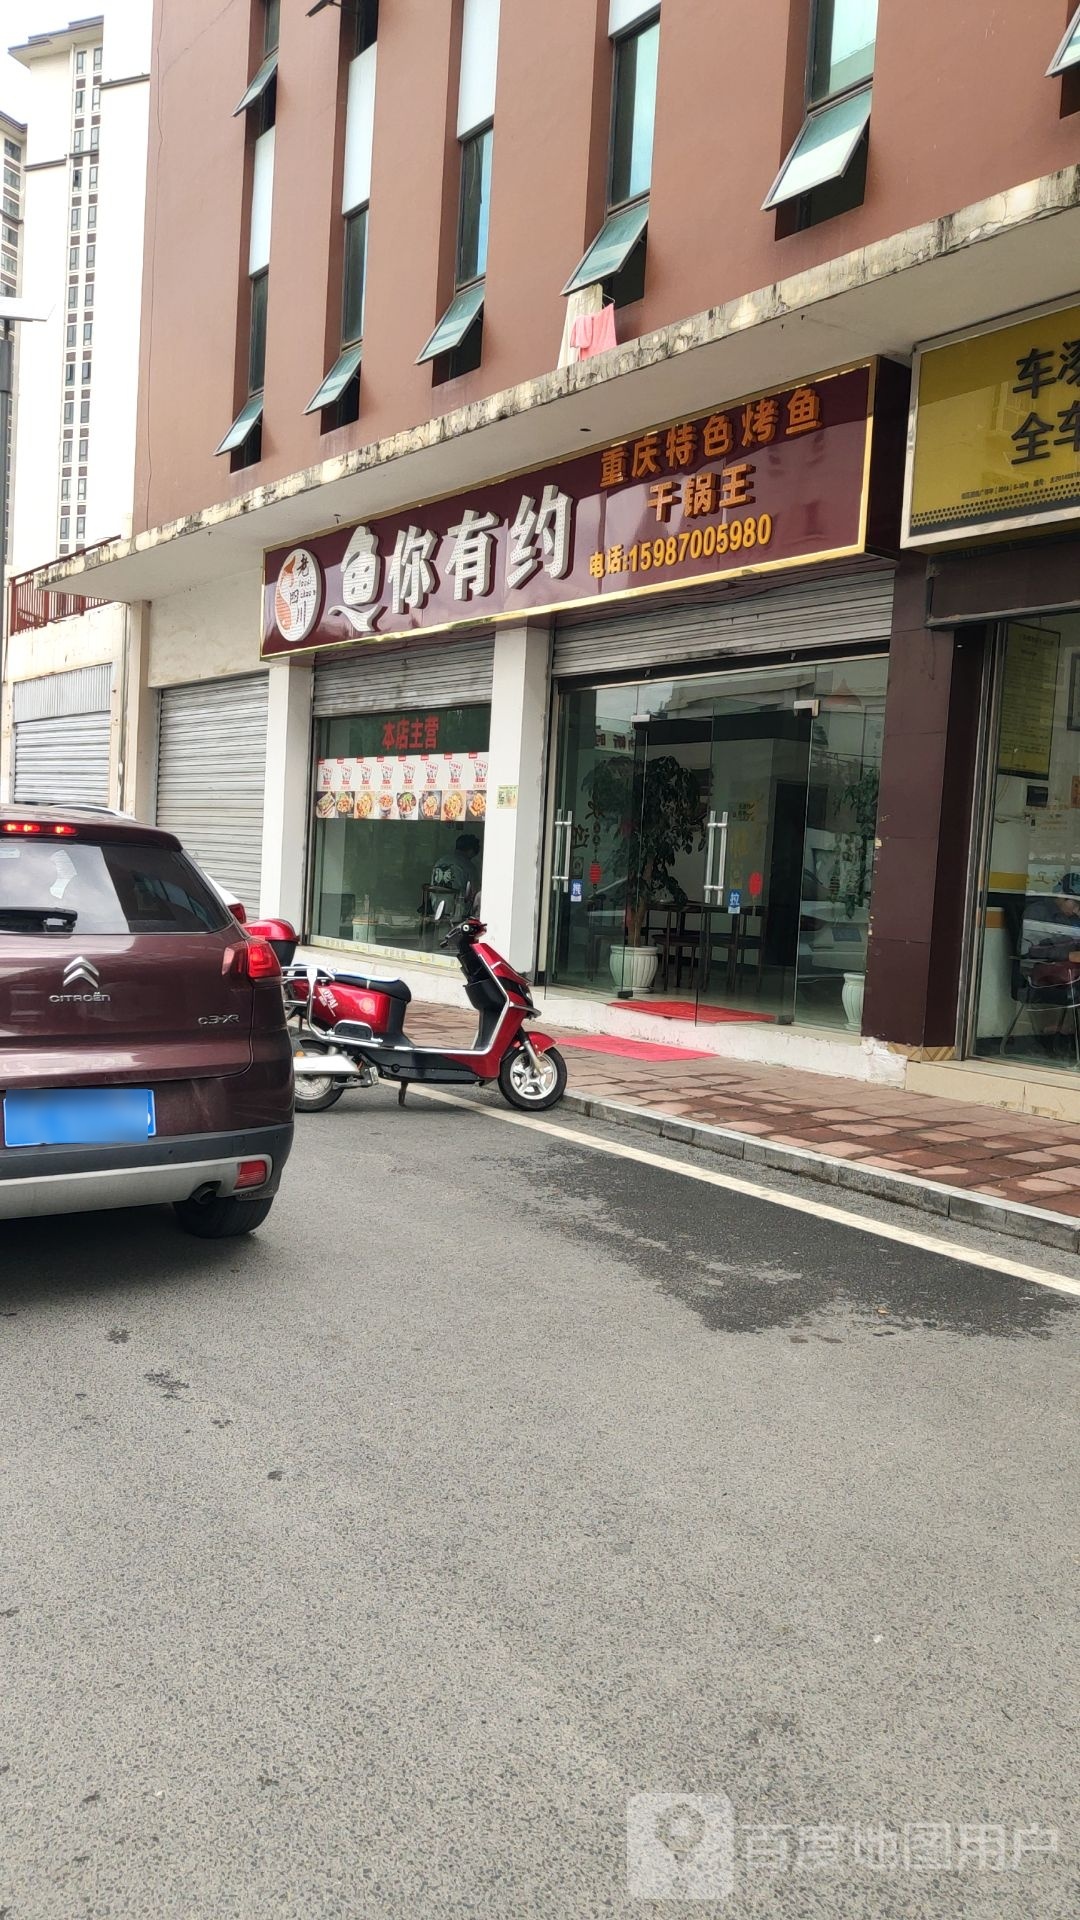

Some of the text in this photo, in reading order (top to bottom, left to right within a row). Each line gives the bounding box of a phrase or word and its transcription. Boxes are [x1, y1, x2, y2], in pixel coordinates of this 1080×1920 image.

[600, 386, 824, 488] 重庆特色烤鱼
[647, 463, 756, 522] 干锅王
[328, 484, 574, 632] 鱼你有约
[382, 714, 440, 750] 本店主营
